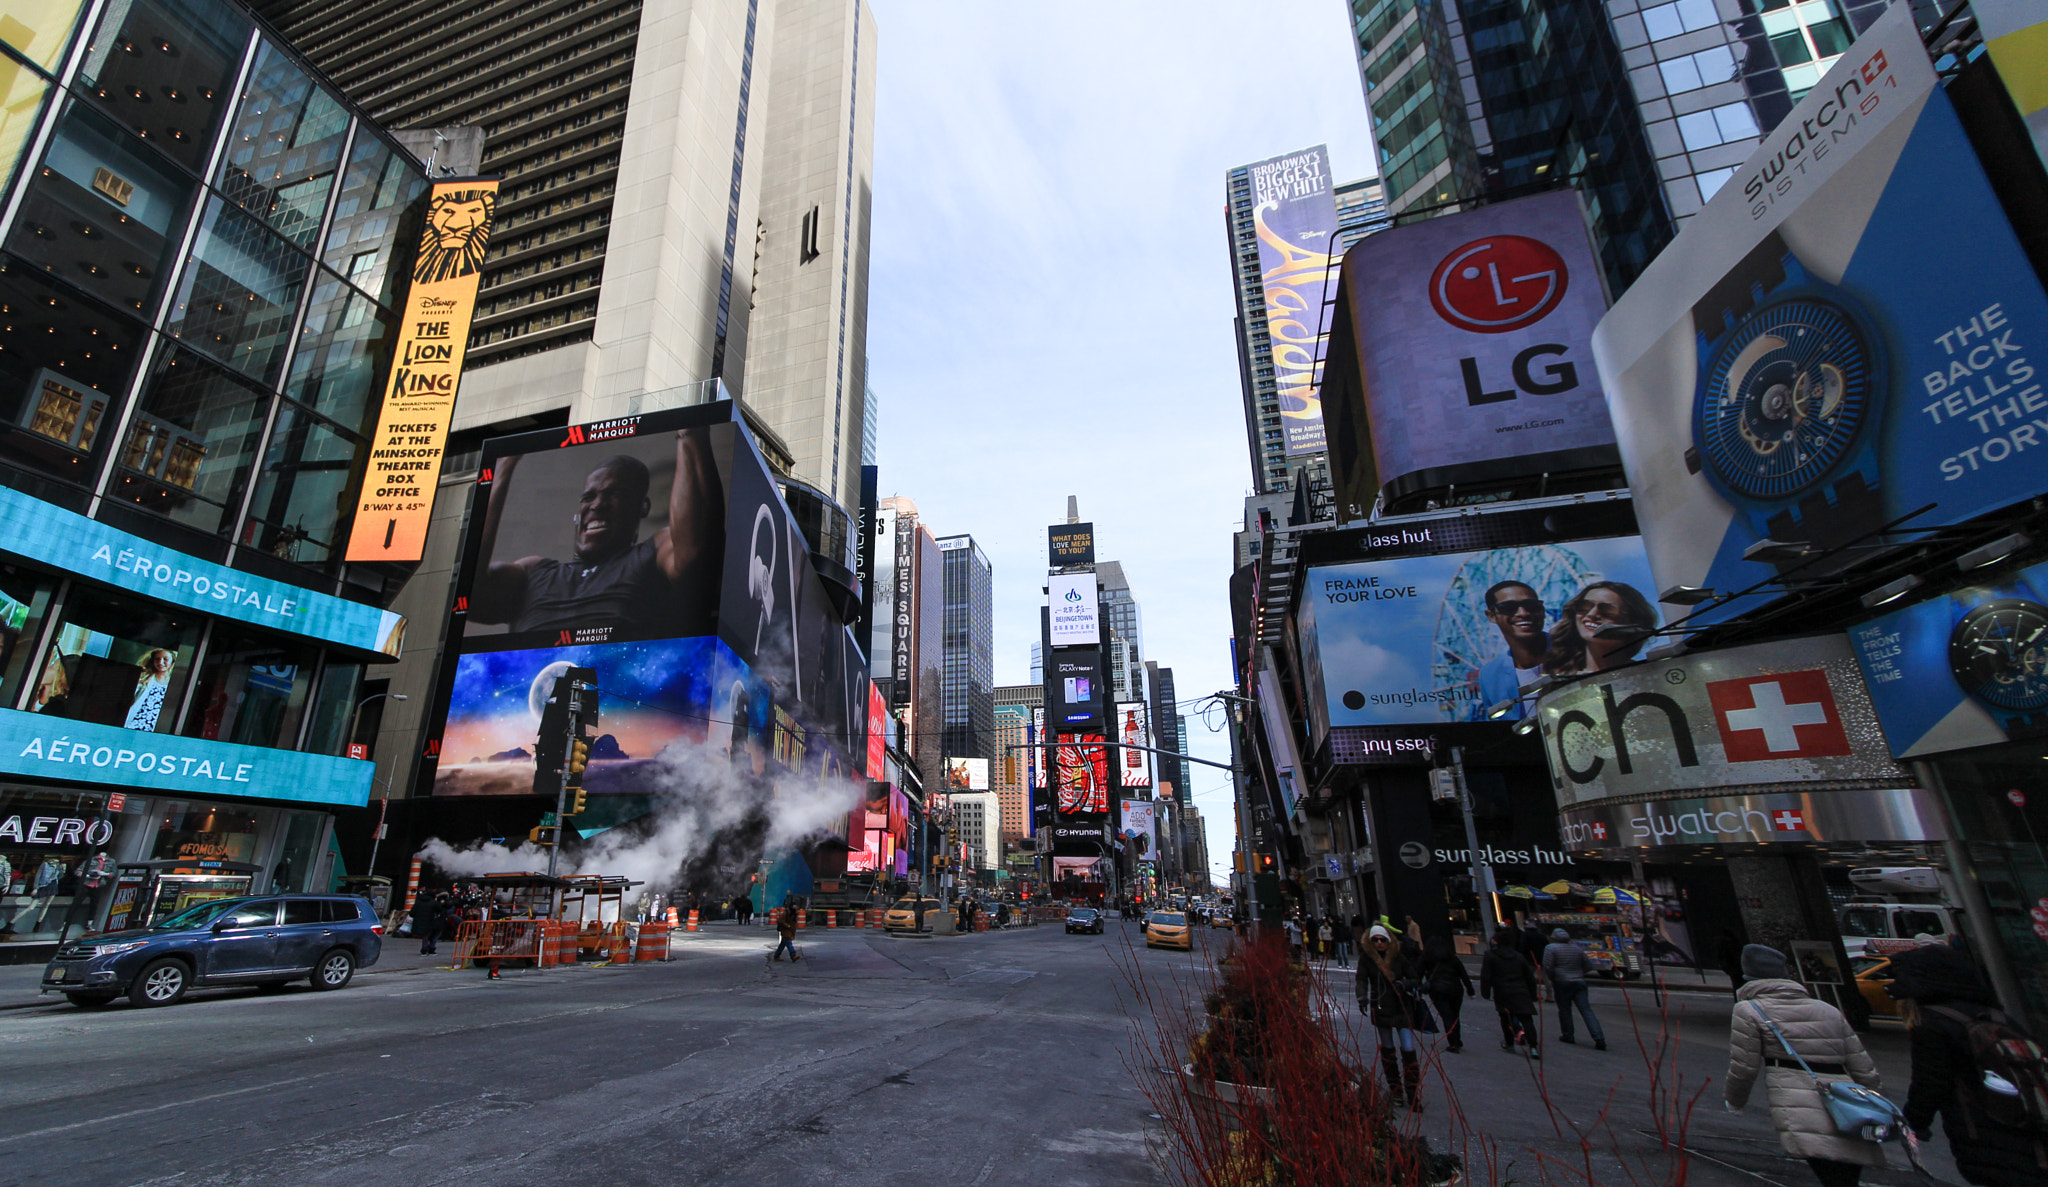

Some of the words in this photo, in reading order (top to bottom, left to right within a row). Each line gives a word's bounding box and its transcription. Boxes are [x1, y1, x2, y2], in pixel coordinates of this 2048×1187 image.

[1744, 73, 1862, 203] swatch
[1255, 161, 1321, 191] BIGGEST
[1257, 182, 1290, 204] NEW
[1298, 230, 1326, 240] Disney
[419, 296, 457, 310] Disney
[416, 321, 450, 337] THE
[1933, 302, 2010, 357] THE
[403, 341, 452, 366] LION
[1923, 329, 2022, 396] BACK
[1459, 343, 1580, 407] LG
[391, 368, 452, 399] KING
[1922, 358, 2036, 425] TELLS
[1968, 384, 2047, 434] THE
[388, 423, 437, 433] TICKETS
[590, 416, 642, 432] MARRIOTT
[1289, 427, 1303, 435] New
[1494, 416, 1565, 434] www.LG.com
[387, 437, 404, 446] AT
[408, 436, 431, 445] THE
[589, 426, 635, 441] MARQUIS
[1290, 432, 1321, 442] Broadway
[372, 449, 441, 459] MINSKOFF
[376, 461, 431, 471] THEATRE
[386, 474, 415, 484] BOX
[376, 488, 420, 497] OFFICE
[396, 503, 403, 511] &
[1052, 534, 1071, 542] WHAT
[1073, 533, 1091, 541] DOES
[1402, 527, 1433, 544] hut
[1071, 540, 1091, 548] MEAN
[898, 531, 911, 593] TIMES
[91, 544, 298, 617] AÉROPOSTALE
[1324, 576, 1380, 592] FRAME
[1326, 589, 1372, 604] YOUR
[1374, 586, 1417, 600] LOVE
[575, 634, 608, 643] MARQUIS
[576, 627, 613, 637] MARRIOTT
[1858, 626, 1882, 639] THE
[896, 600, 910, 681] SQUARE
[1862, 632, 1900, 651] FRONT
[1865, 644, 1901, 661] TELLS
[1870, 659, 1894, 671] THE
[1873, 669, 1902, 685] TIME
[1370, 688, 1447, 708] sunglass
[1448, 686, 1481, 702] hut
[20, 736, 253, 784] AÉROPOSTALE
[1130, 811, 1146, 819] ADD
[0, 815, 113, 845] AERO
[1630, 806, 1772, 846] swatch
[216, 845, 242, 856] SALE
[1434, 844, 1531, 867] sunglass
